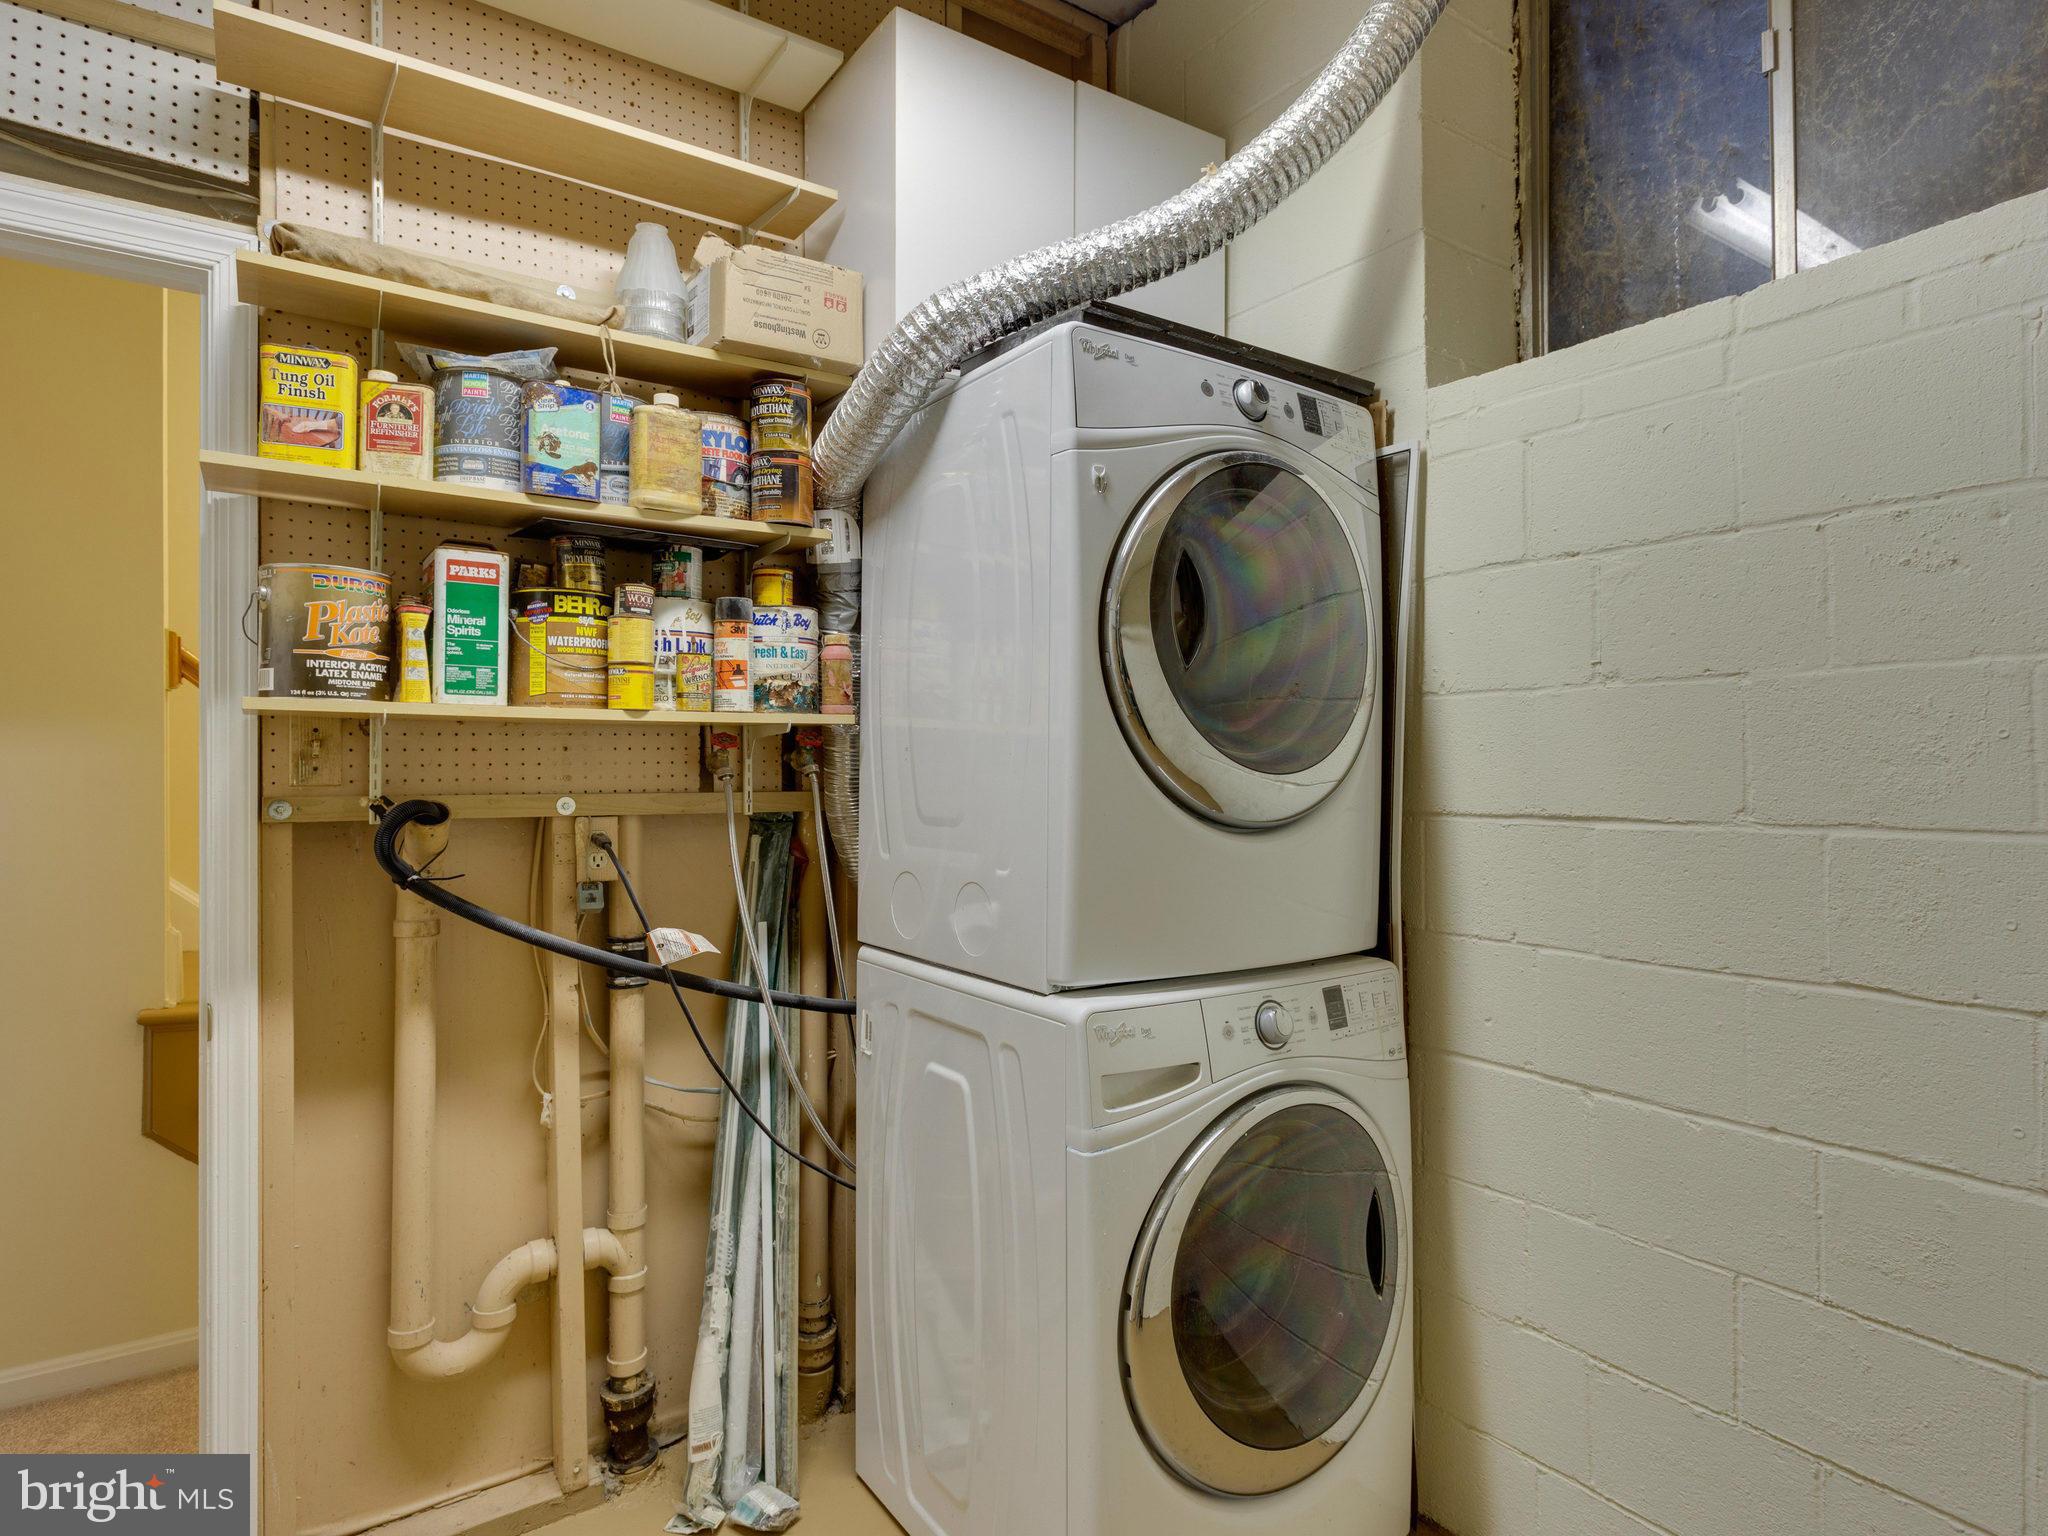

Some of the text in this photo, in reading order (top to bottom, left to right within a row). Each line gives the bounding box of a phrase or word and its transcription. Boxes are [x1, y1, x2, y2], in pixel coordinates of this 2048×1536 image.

[753, 320, 807, 339] Westinghouse
[279, 353, 328, 369] MINWAX
[270, 368, 335, 387] Tung Oil
[278, 383, 326, 399] Finish
[463, 388, 487, 396] PAINTS
[450, 397, 502, 418] Bright
[370, 420, 419, 432] FURNITURE
[370, 428, 418, 438] REFINISHER
[455, 414, 488, 438] Life
[450, 438, 500, 446] INTERIOR
[449, 565, 497, 579] PARKS
[311, 573, 387, 598] DURON
[554, 594, 600, 616] BEHR
[627, 594, 654, 605] WOOD
[302, 598, 390, 641] Plastic
[447, 614, 486, 626] Mineral
[685, 607, 702, 623] Boy
[793, 613, 812, 630] Boy
[446, 624, 481, 637] Spirits
[576, 626, 597, 637] NWF
[730, 625, 746, 634] 3M
[780, 646, 788, 659] &
[790, 646, 808, 661] Easy
[306, 659, 387, 673] INTERIOR ACRYLIC
[315, 668, 383, 681] LATEX ENAMEL
[328, 679, 361, 687] MIDTONE
